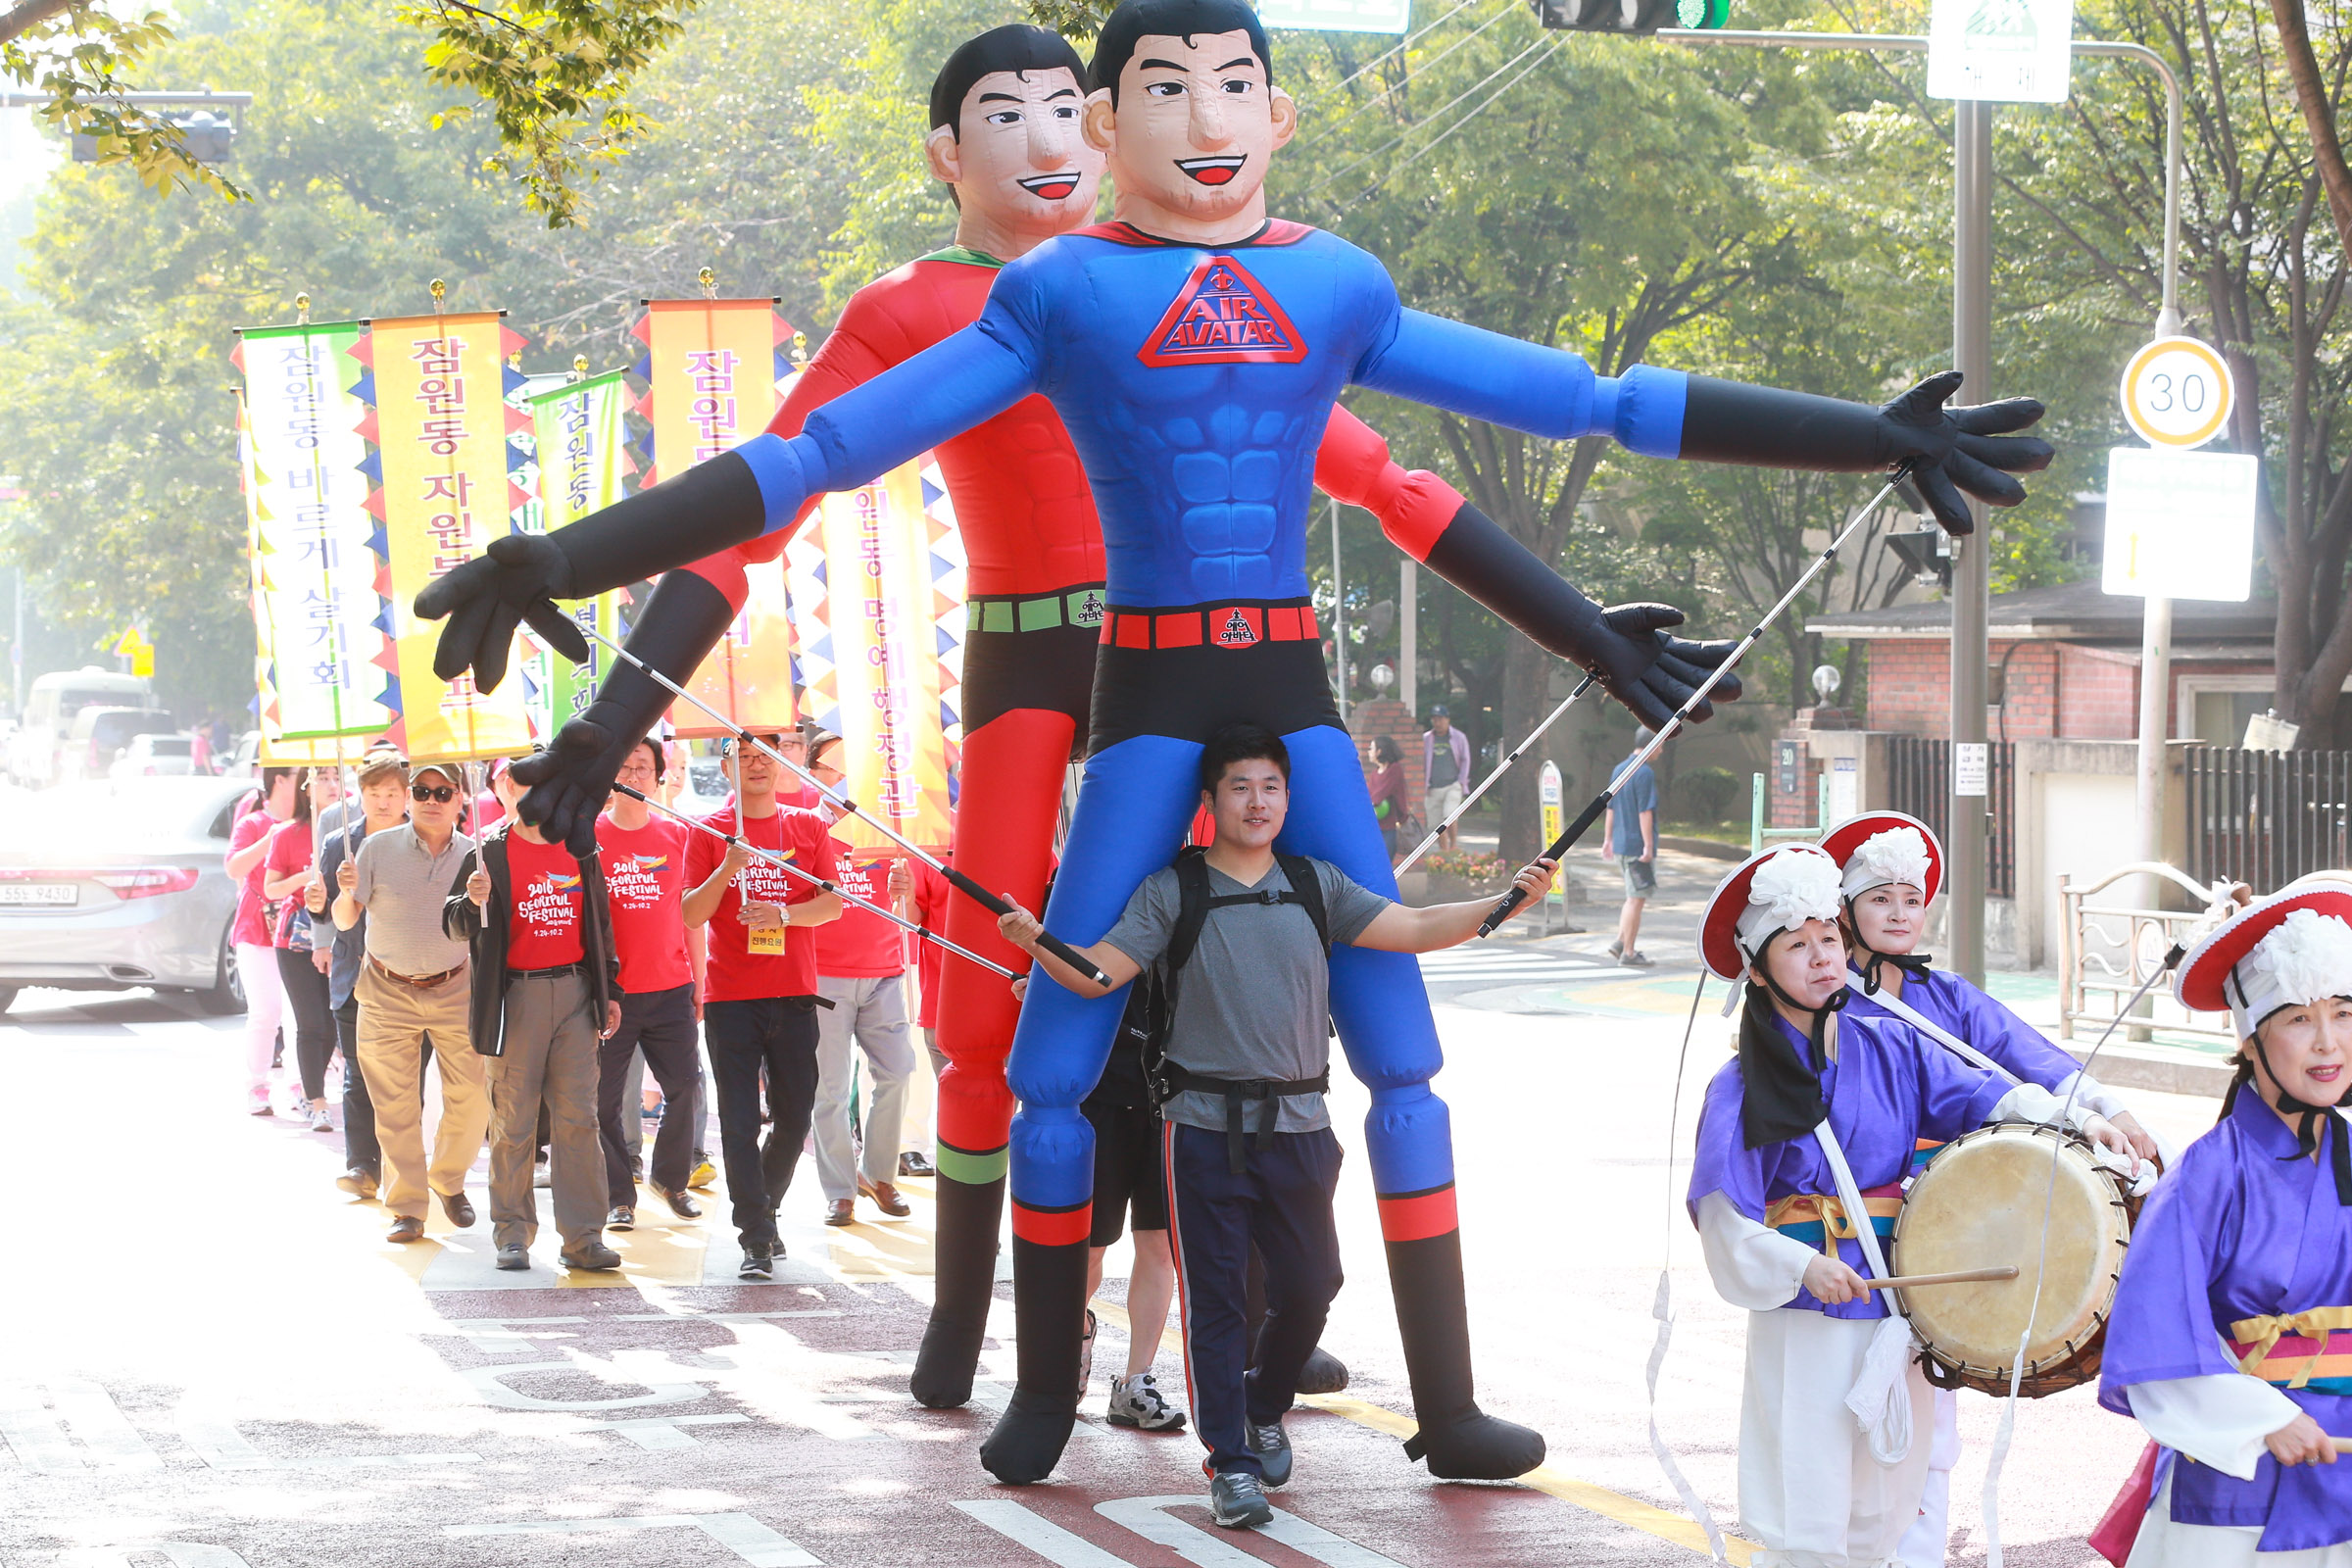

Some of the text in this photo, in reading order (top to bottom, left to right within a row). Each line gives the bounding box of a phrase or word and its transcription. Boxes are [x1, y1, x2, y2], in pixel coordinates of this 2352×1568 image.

[1183, 297, 1270, 321] AIR
[1164, 319, 1286, 348] AVATAR
[412, 337, 468, 455] 잠원동
[2150, 373, 2205, 413] 30
[559, 392, 598, 510] 잠원동
[279, 345, 350, 689] 잠원동 바르게 살기회
[863, 599, 920, 817] 명예행정관
[1782, 748, 1794, 766] 20
[612, 859, 640, 875] 2016
[36, 887, 71, 901] 9430
[527, 878, 555, 898] 2016
[613, 884, 664, 898] FESTIVAL
[517, 893, 572, 918] SEORIPUL
[529, 906, 577, 924] FESTIVAL
